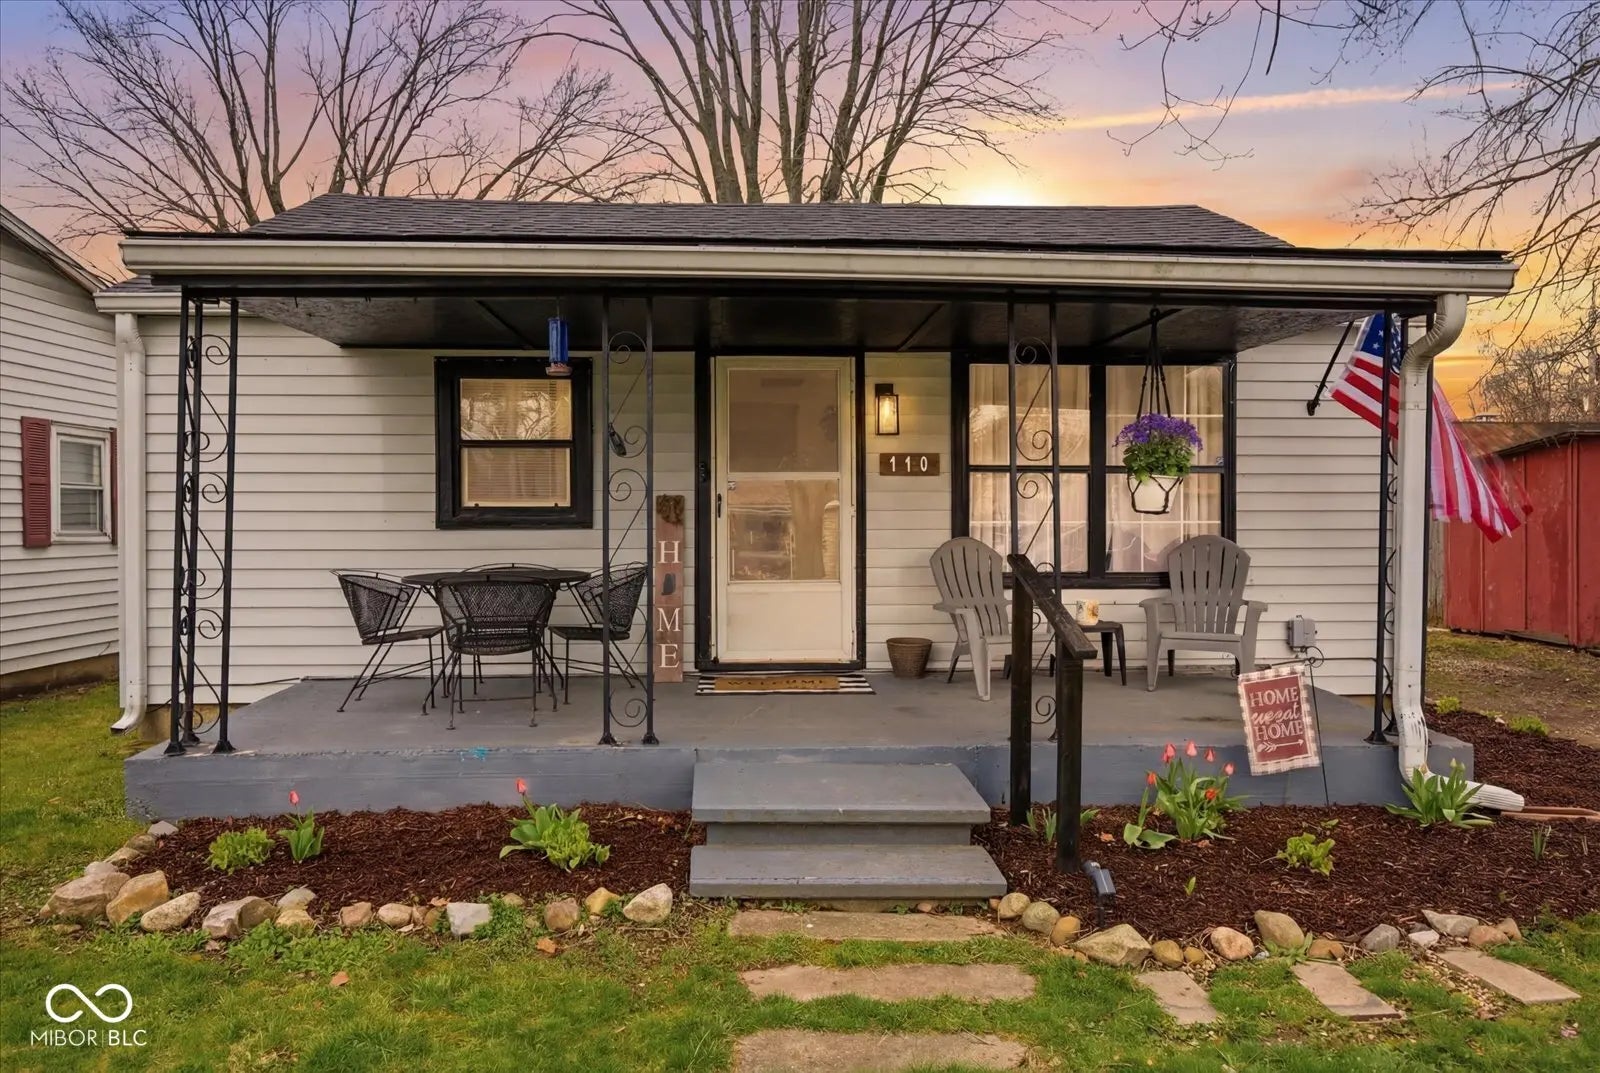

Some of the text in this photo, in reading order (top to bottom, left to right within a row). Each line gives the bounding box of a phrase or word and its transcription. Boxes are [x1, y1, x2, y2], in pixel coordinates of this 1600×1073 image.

[889, 455, 928, 472] 110
[657, 540, 681, 668] HME
[1249, 686, 1299, 708] HOME
[1252, 720, 1305, 741] HOME
